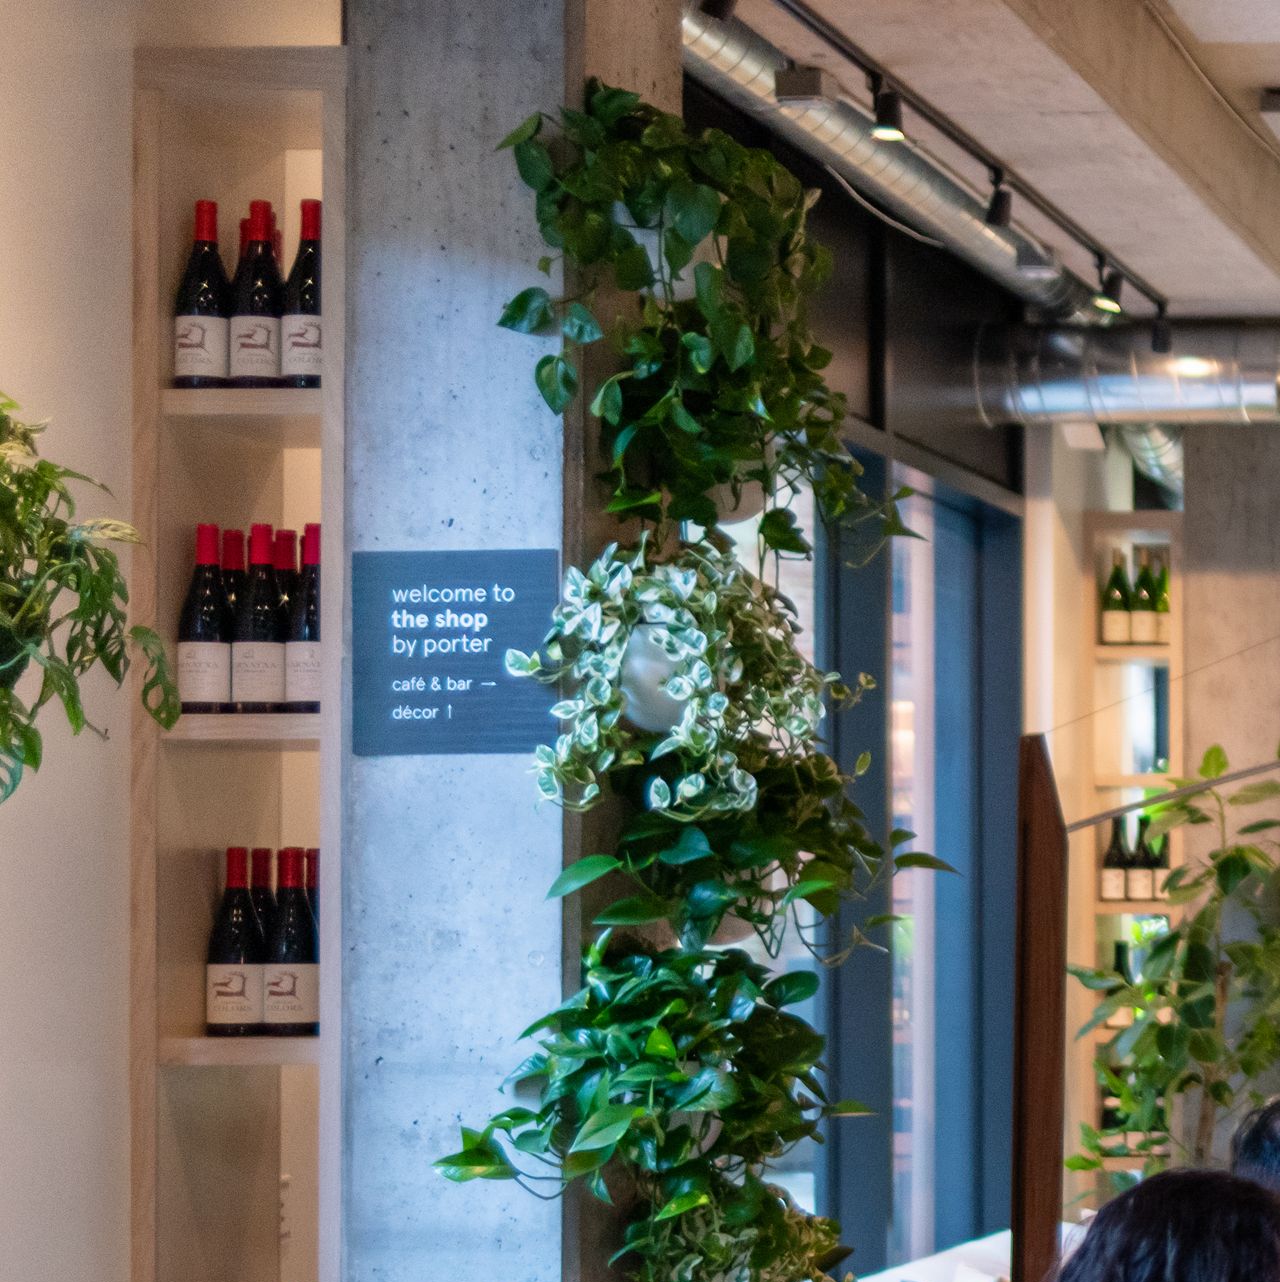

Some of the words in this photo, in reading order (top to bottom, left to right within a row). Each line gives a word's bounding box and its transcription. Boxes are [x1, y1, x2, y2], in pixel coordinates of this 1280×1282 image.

[393, 584, 486, 603] welcome
[493, 584, 515, 602] to
[391, 610, 429, 628] the
[435, 609, 487, 631] shop
[393, 635, 416, 657] by
[424, 634, 492, 657] porter
[392, 677, 425, 691] café
[431, 677, 441, 691] &
[447, 677, 472, 690] bar
[393, 705, 438, 719] décor
